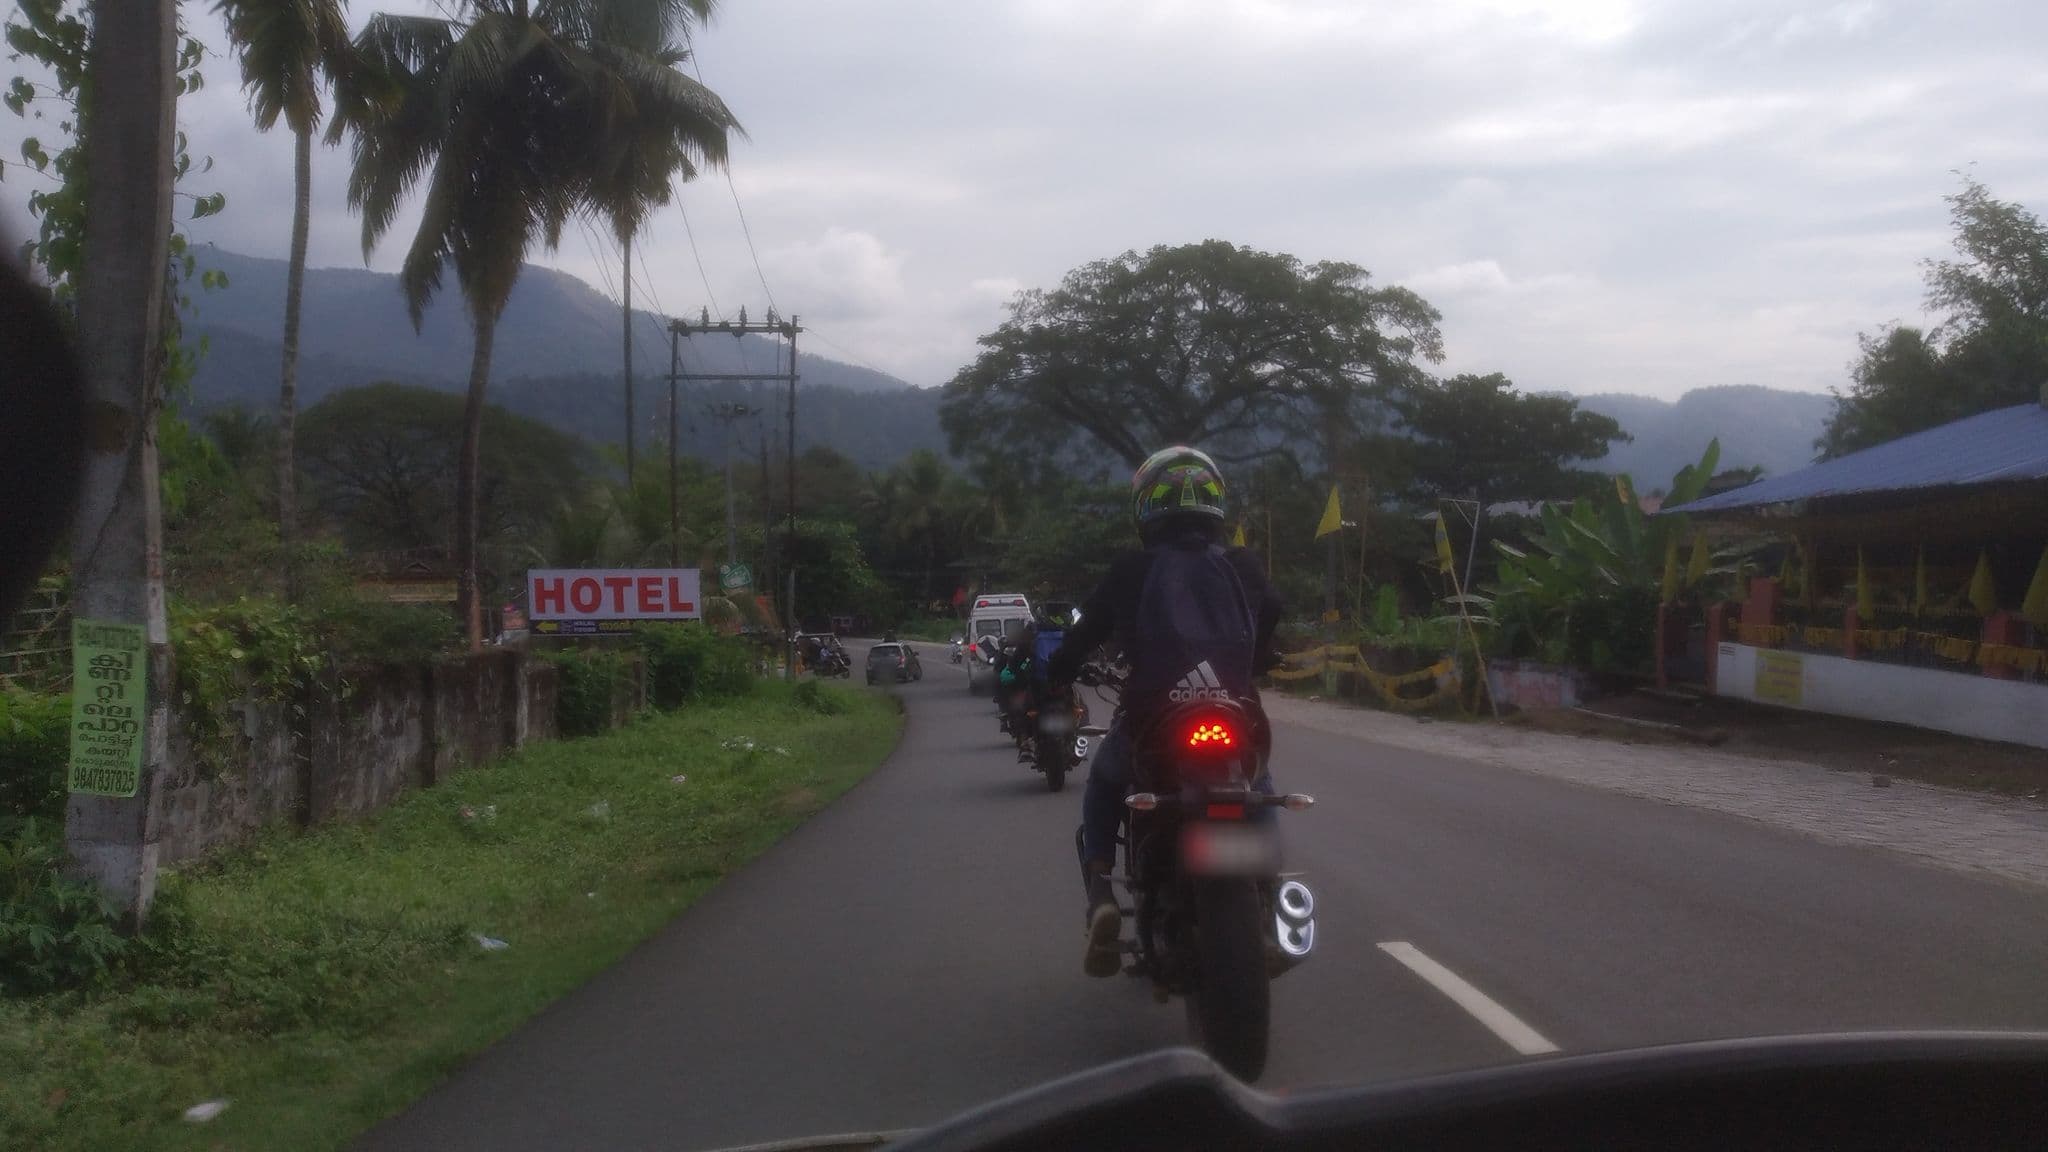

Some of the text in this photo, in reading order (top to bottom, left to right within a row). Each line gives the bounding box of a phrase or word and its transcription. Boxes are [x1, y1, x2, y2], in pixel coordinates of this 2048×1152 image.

[534, 576, 694, 614] HOTEL
[1168, 686, 1229, 702] adidas
[73, 766, 135, 794] 9847837825
